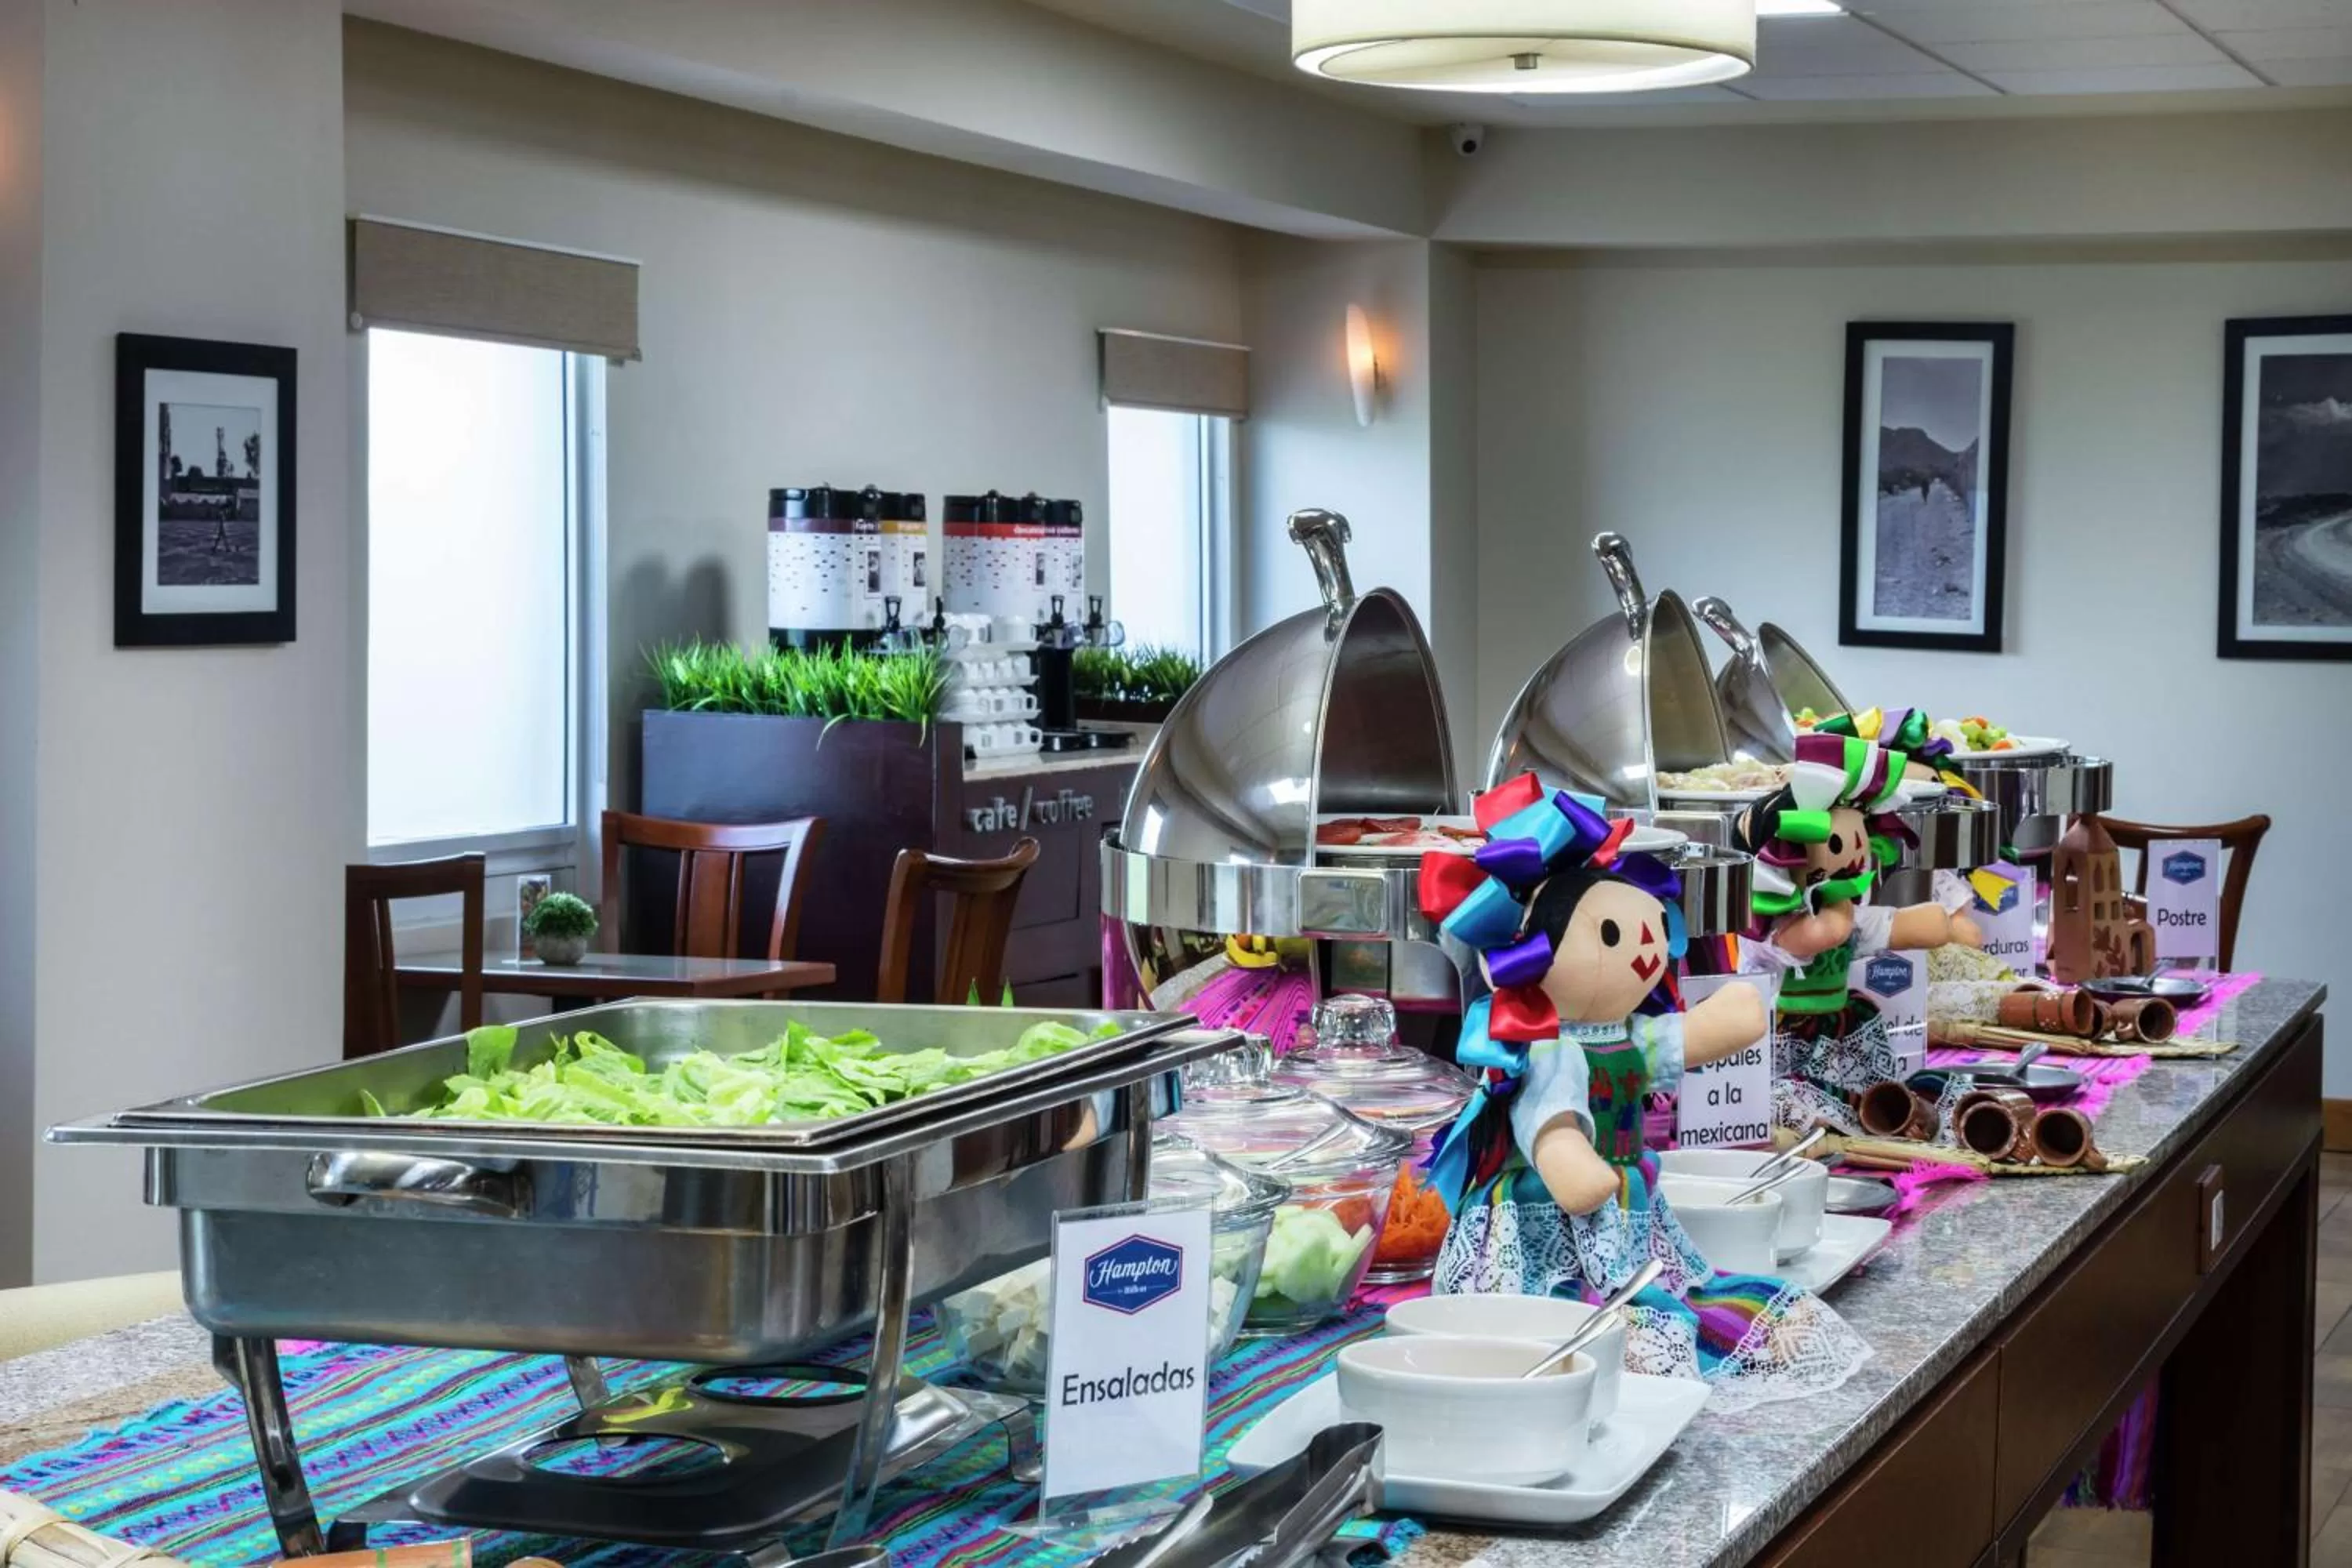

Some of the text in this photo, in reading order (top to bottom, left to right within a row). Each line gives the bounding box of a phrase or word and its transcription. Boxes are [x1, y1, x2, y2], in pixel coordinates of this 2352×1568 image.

[2158, 907, 2207, 926] Postre
[1983, 938, 2029, 955] rduras
[1705, 1048, 1762, 1073] pales
[1707, 1082, 1742, 1106] a la
[1680, 1121, 1768, 1146] mexicana
[1089, 1255, 1178, 1288] Hampton
[1062, 1361, 1195, 1406] Ensaladas
